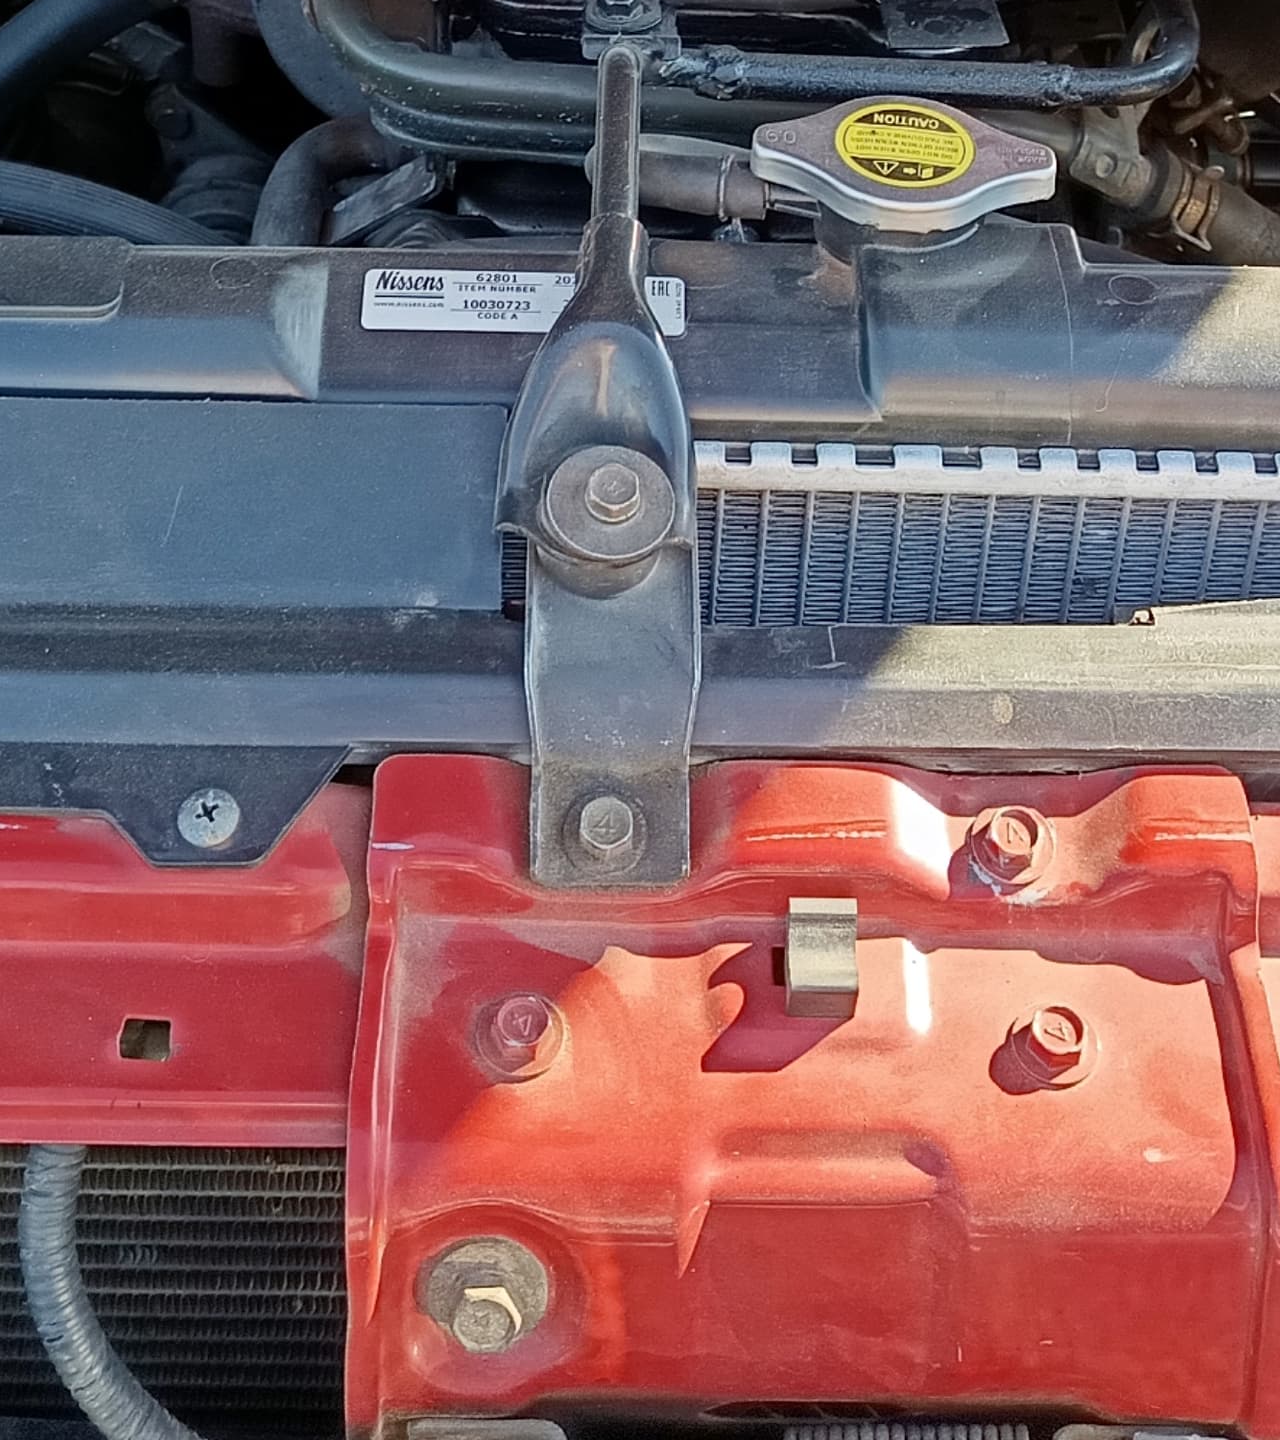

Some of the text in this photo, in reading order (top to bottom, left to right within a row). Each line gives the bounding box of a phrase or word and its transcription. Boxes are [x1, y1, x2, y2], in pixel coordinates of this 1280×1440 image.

[873, 113, 939, 130] CAUTION
[375, 270, 445, 292] Nissens
[475, 272, 519, 283] 62801
[458, 284, 537, 294] ITEM NUMBER
[462, 299, 532, 311] 10030723
[477, 312, 519, 321] CODE A
